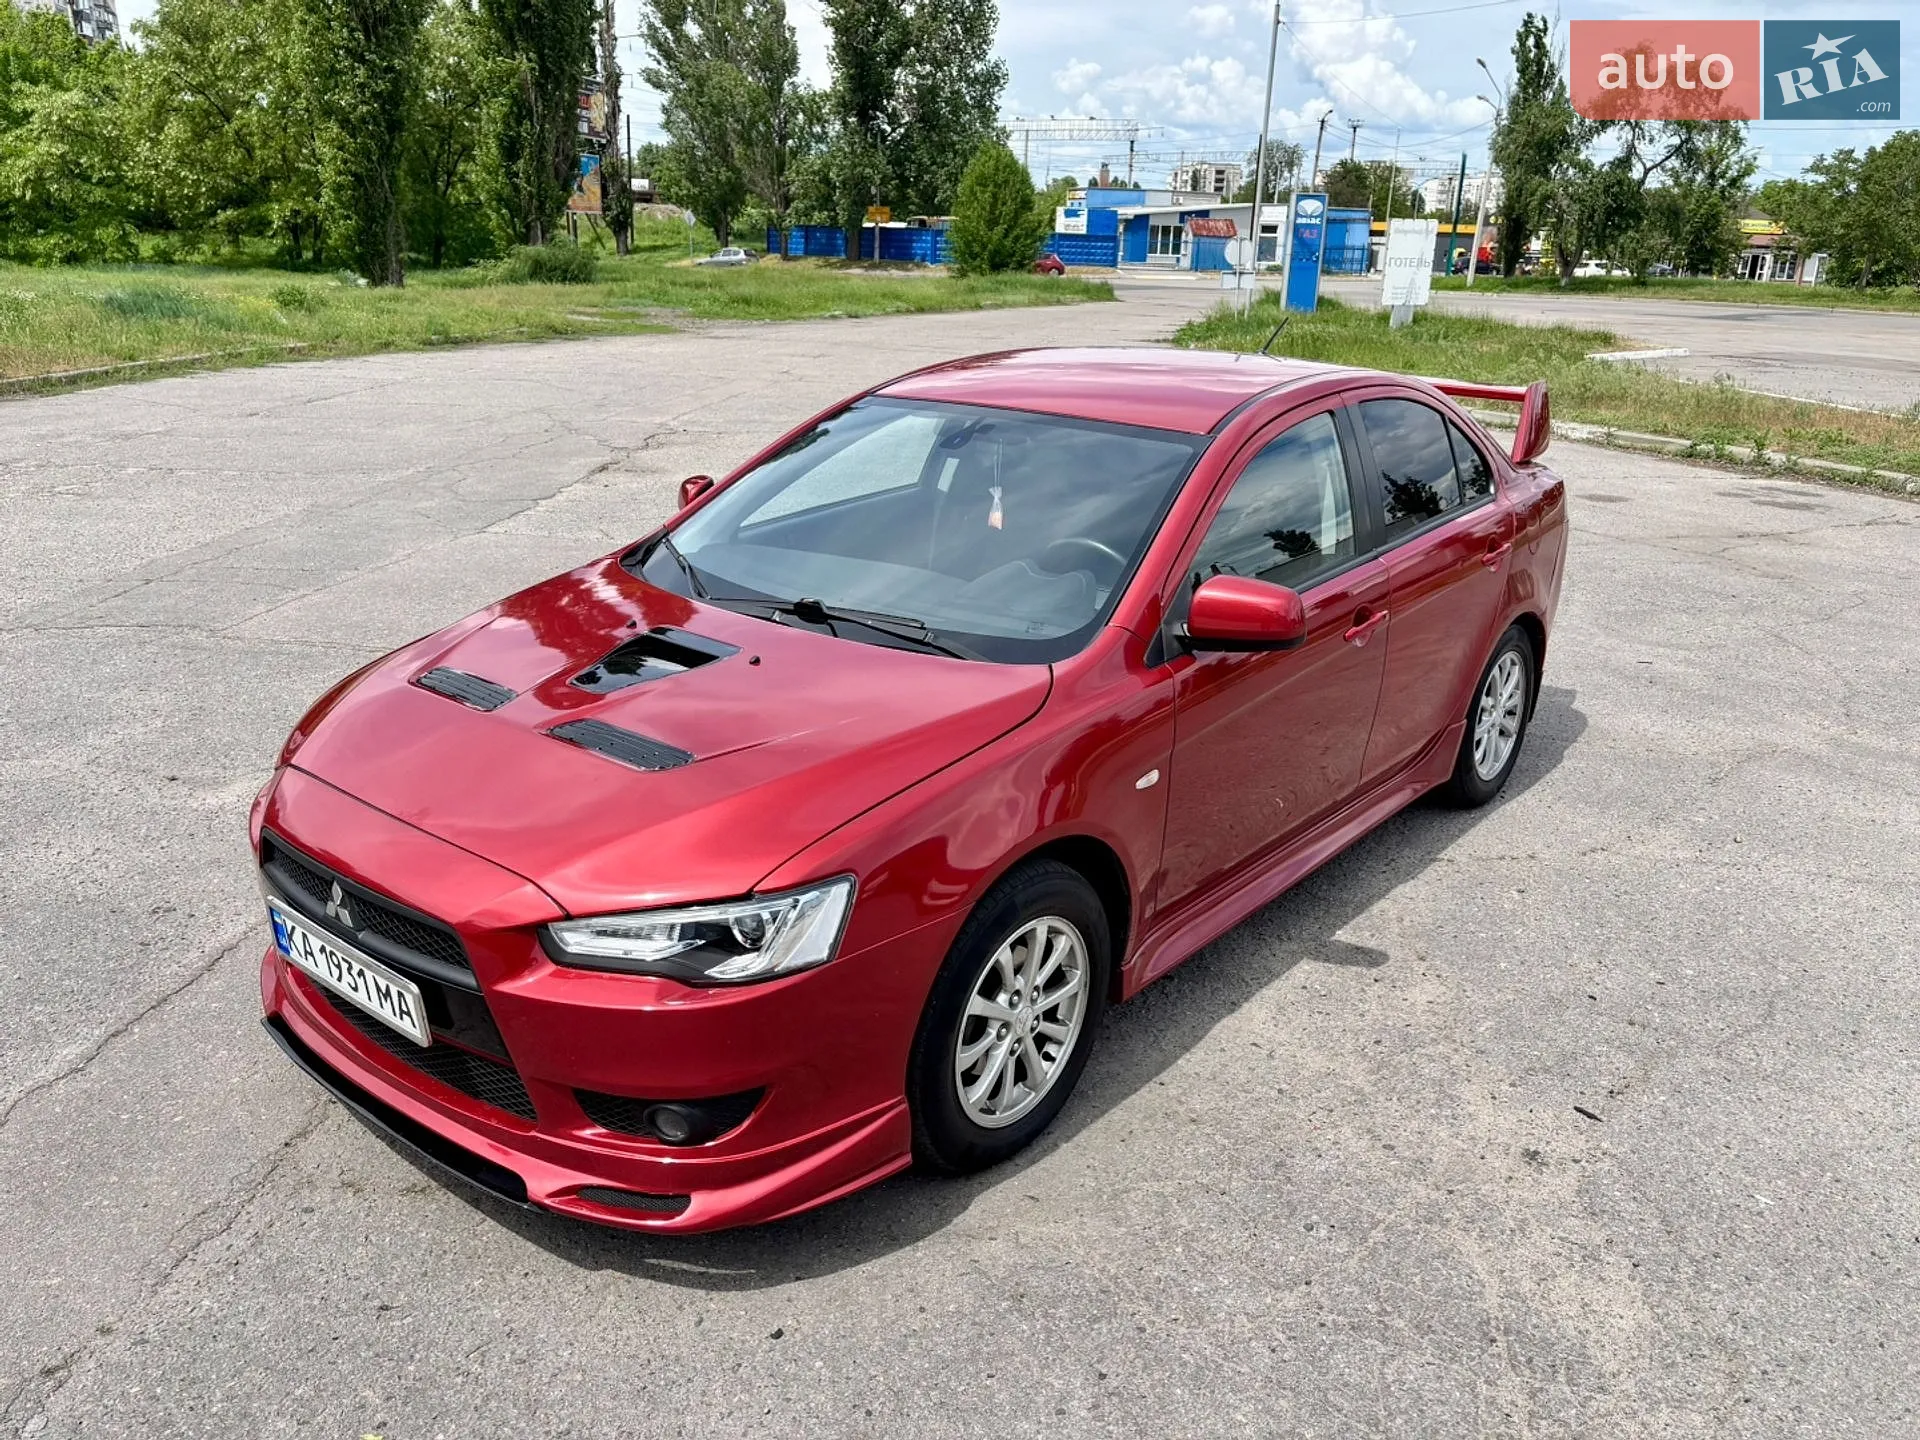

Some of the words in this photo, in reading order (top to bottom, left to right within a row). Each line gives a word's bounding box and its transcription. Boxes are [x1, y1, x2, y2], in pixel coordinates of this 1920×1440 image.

[1388, 257, 1431, 268] ГОТЕЛЬ
[283, 919, 319, 969] KA
[319, 944, 372, 1003] 1931
[373, 974, 417, 1029] MA
